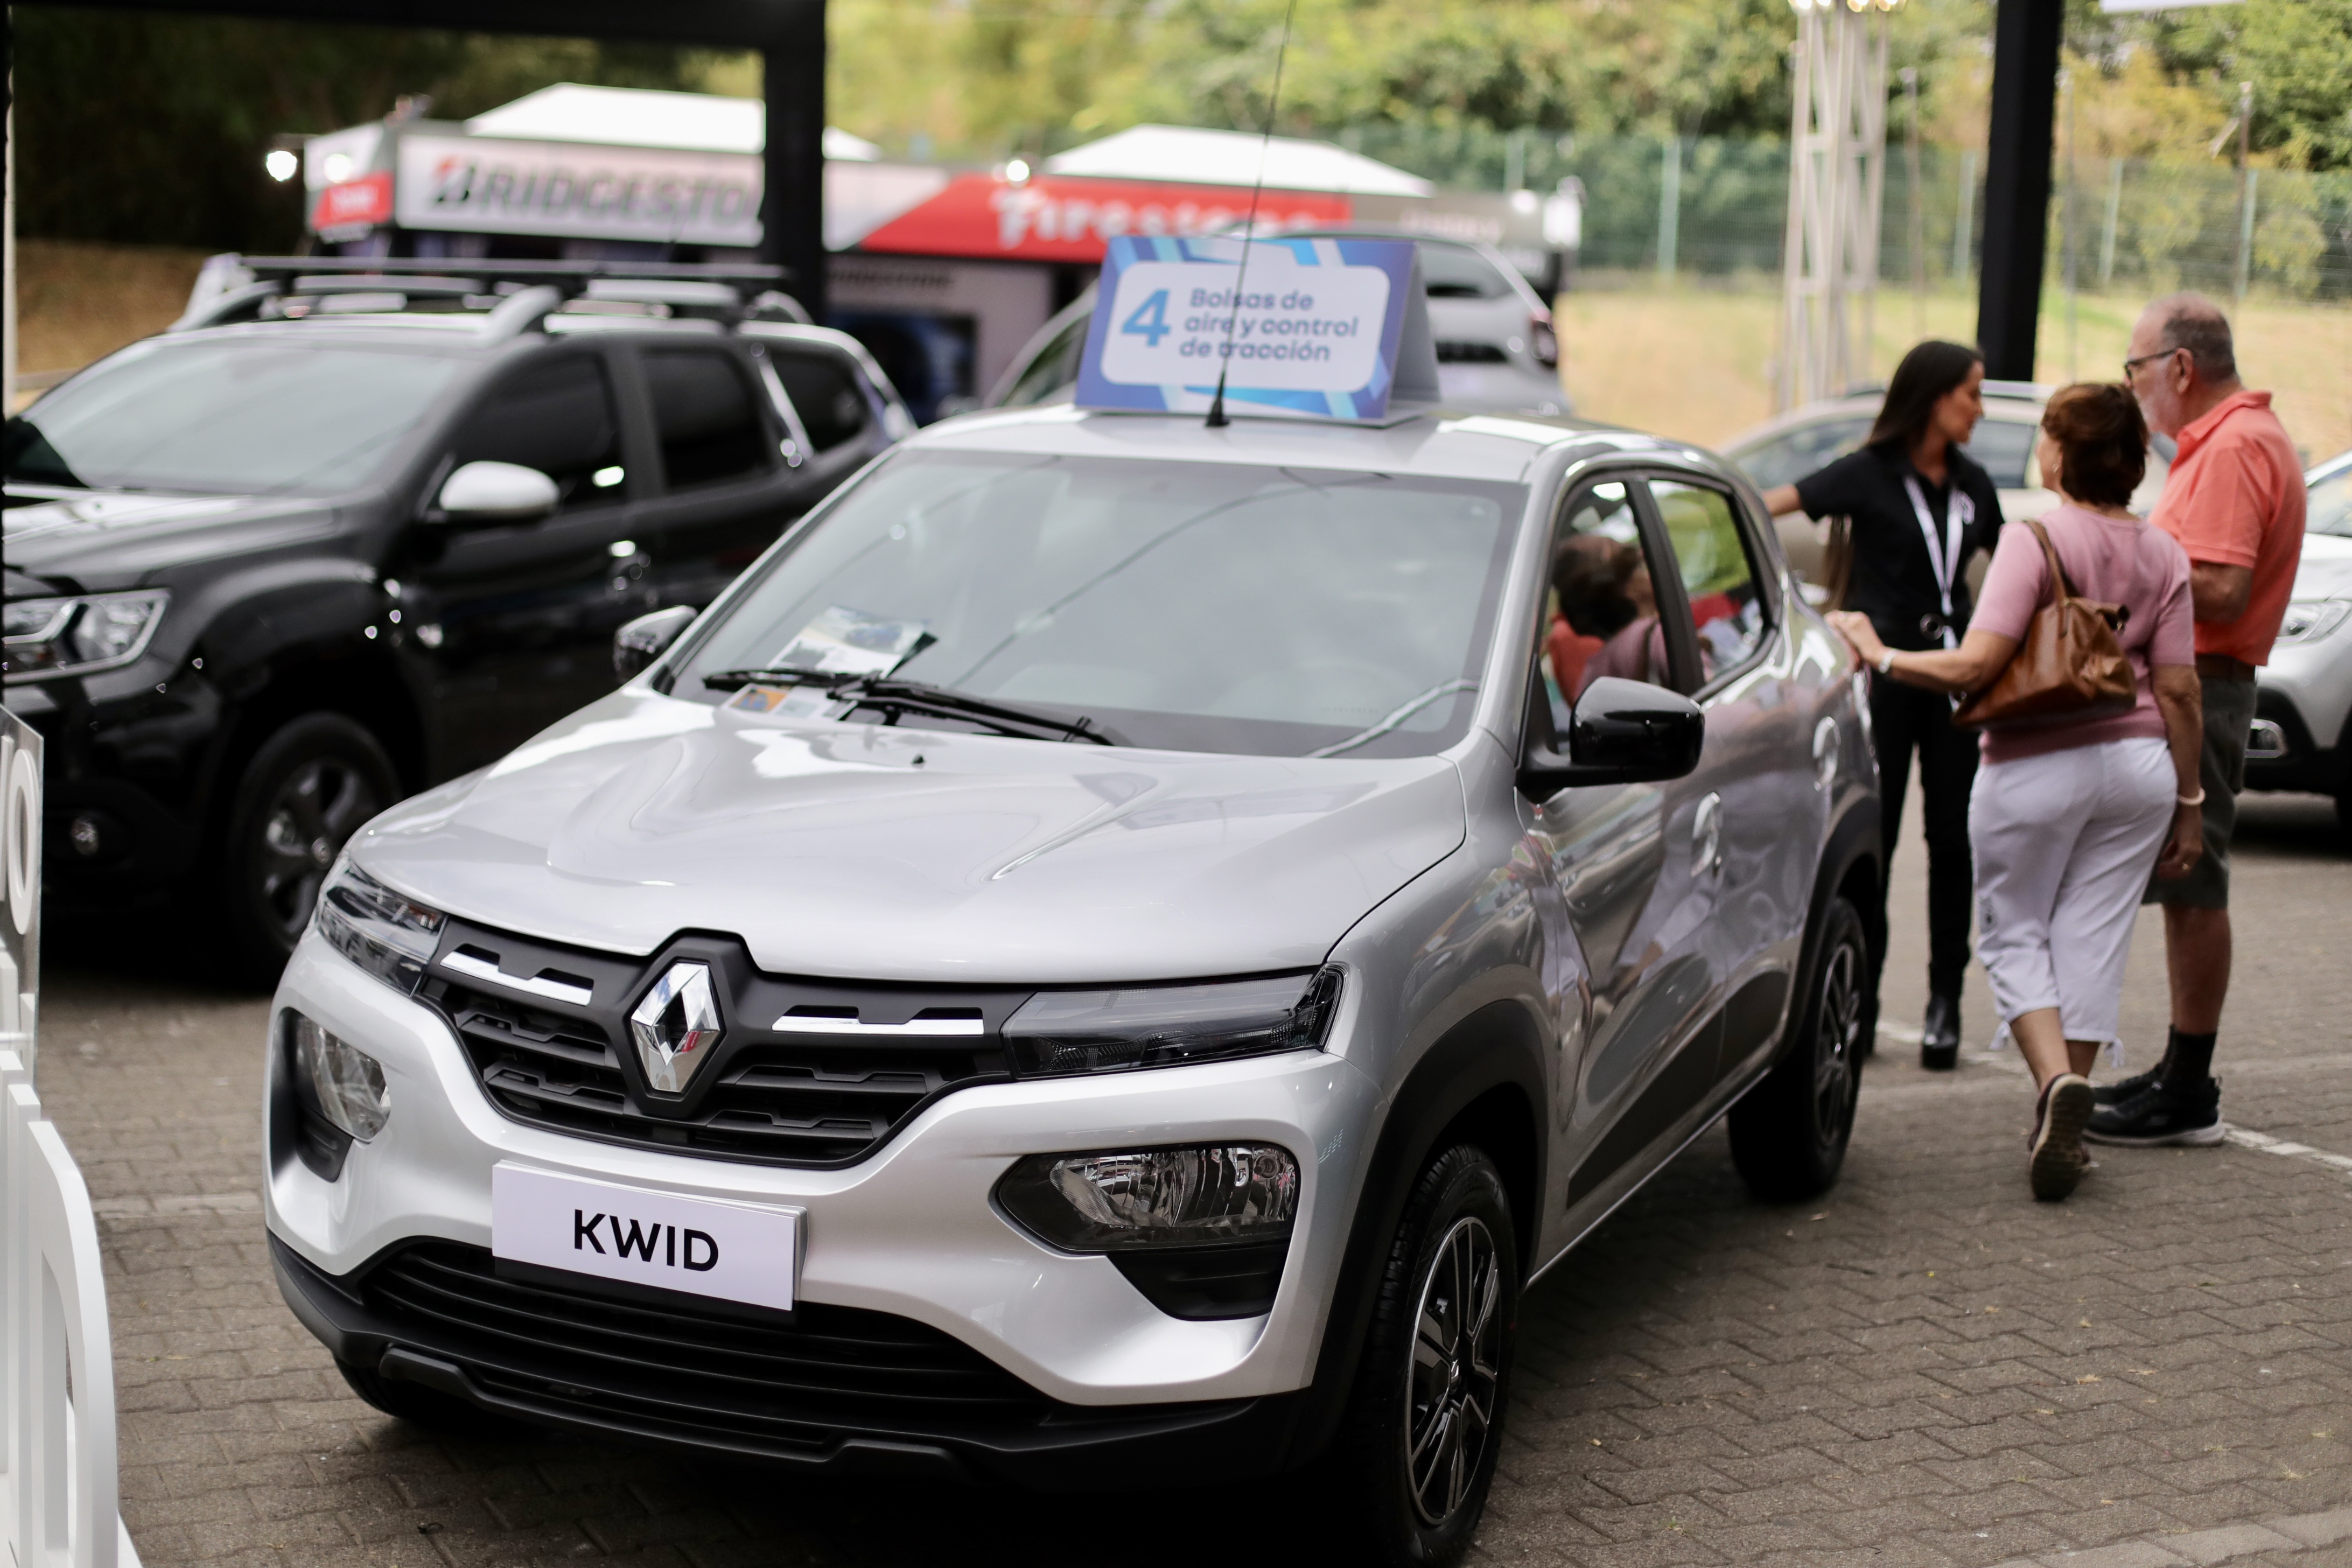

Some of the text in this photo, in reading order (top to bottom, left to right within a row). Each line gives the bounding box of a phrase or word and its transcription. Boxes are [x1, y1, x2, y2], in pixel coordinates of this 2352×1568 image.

[1190, 287, 1314, 310] Bolsas de
[1121, 289, 1171, 347] 4
[1184, 311, 1359, 338] aire y control
[1179, 337, 1331, 362] de tracción
[574, 1208, 719, 1272] KWID
